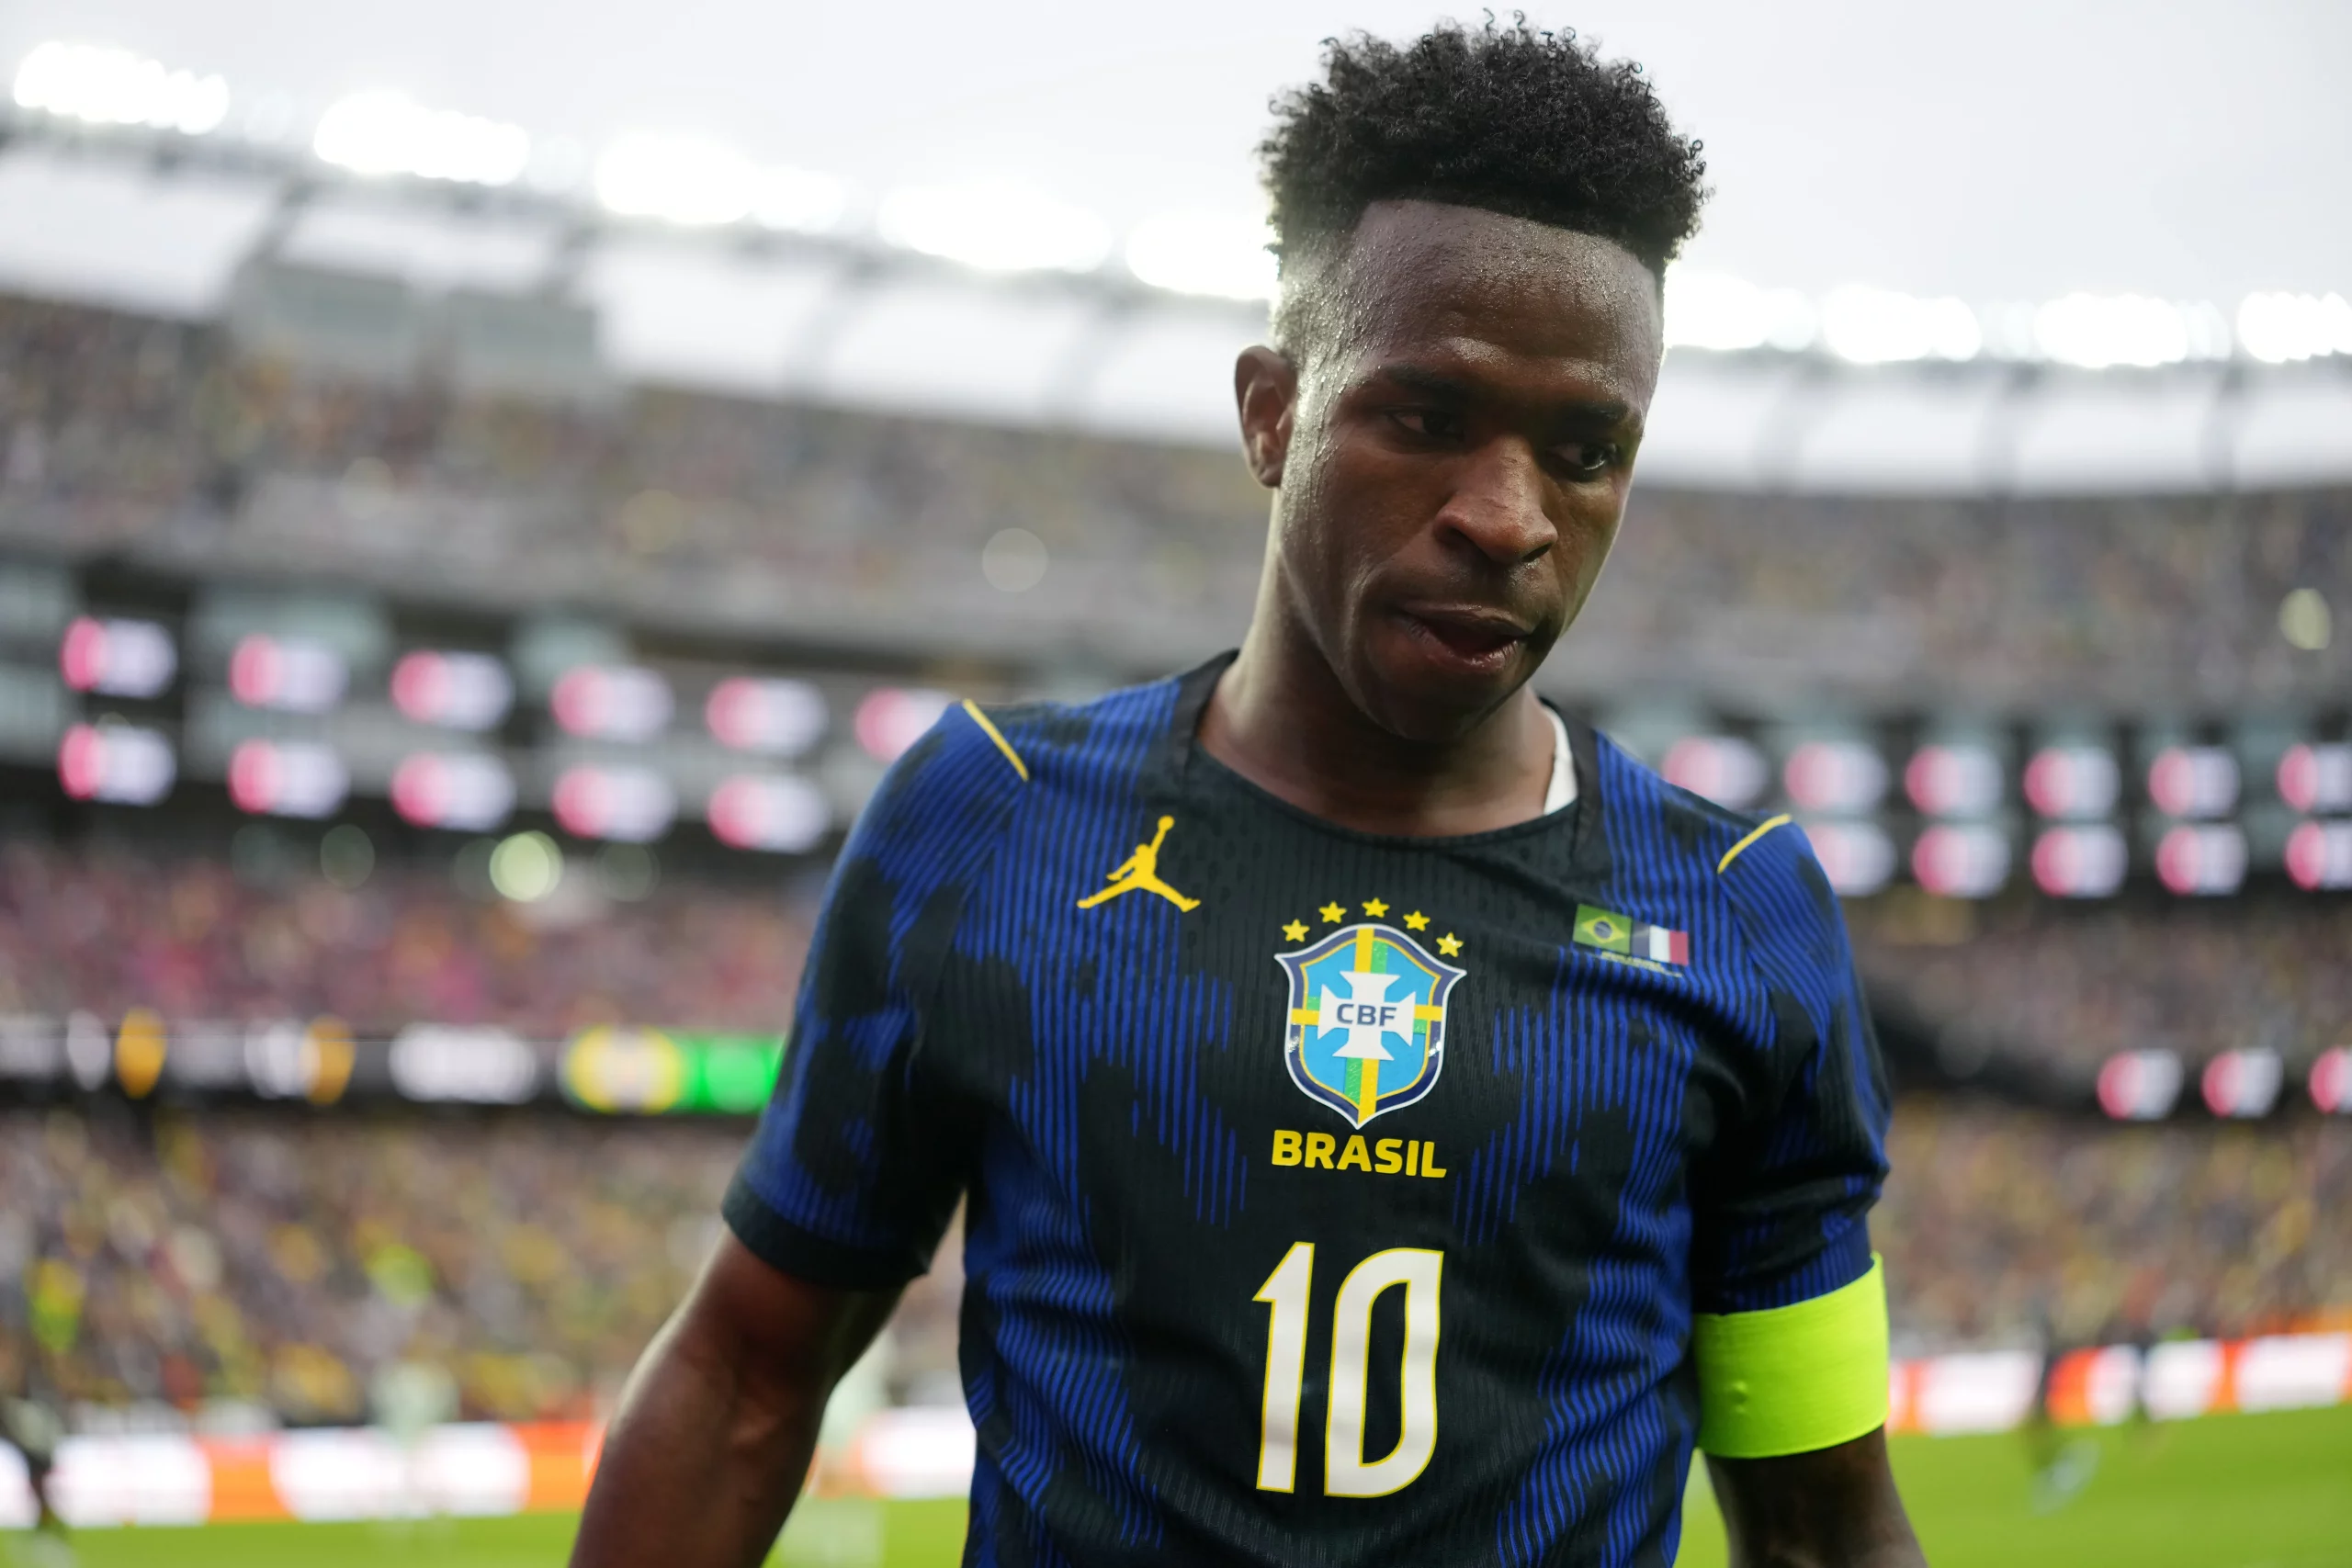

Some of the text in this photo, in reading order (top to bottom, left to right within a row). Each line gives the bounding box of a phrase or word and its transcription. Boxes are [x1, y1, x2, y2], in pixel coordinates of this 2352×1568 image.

[1337, 1003, 1397, 1027] CBF
[1272, 1130, 1447, 1179] BRASIL
[1252, 1241, 1444, 1498] 10
